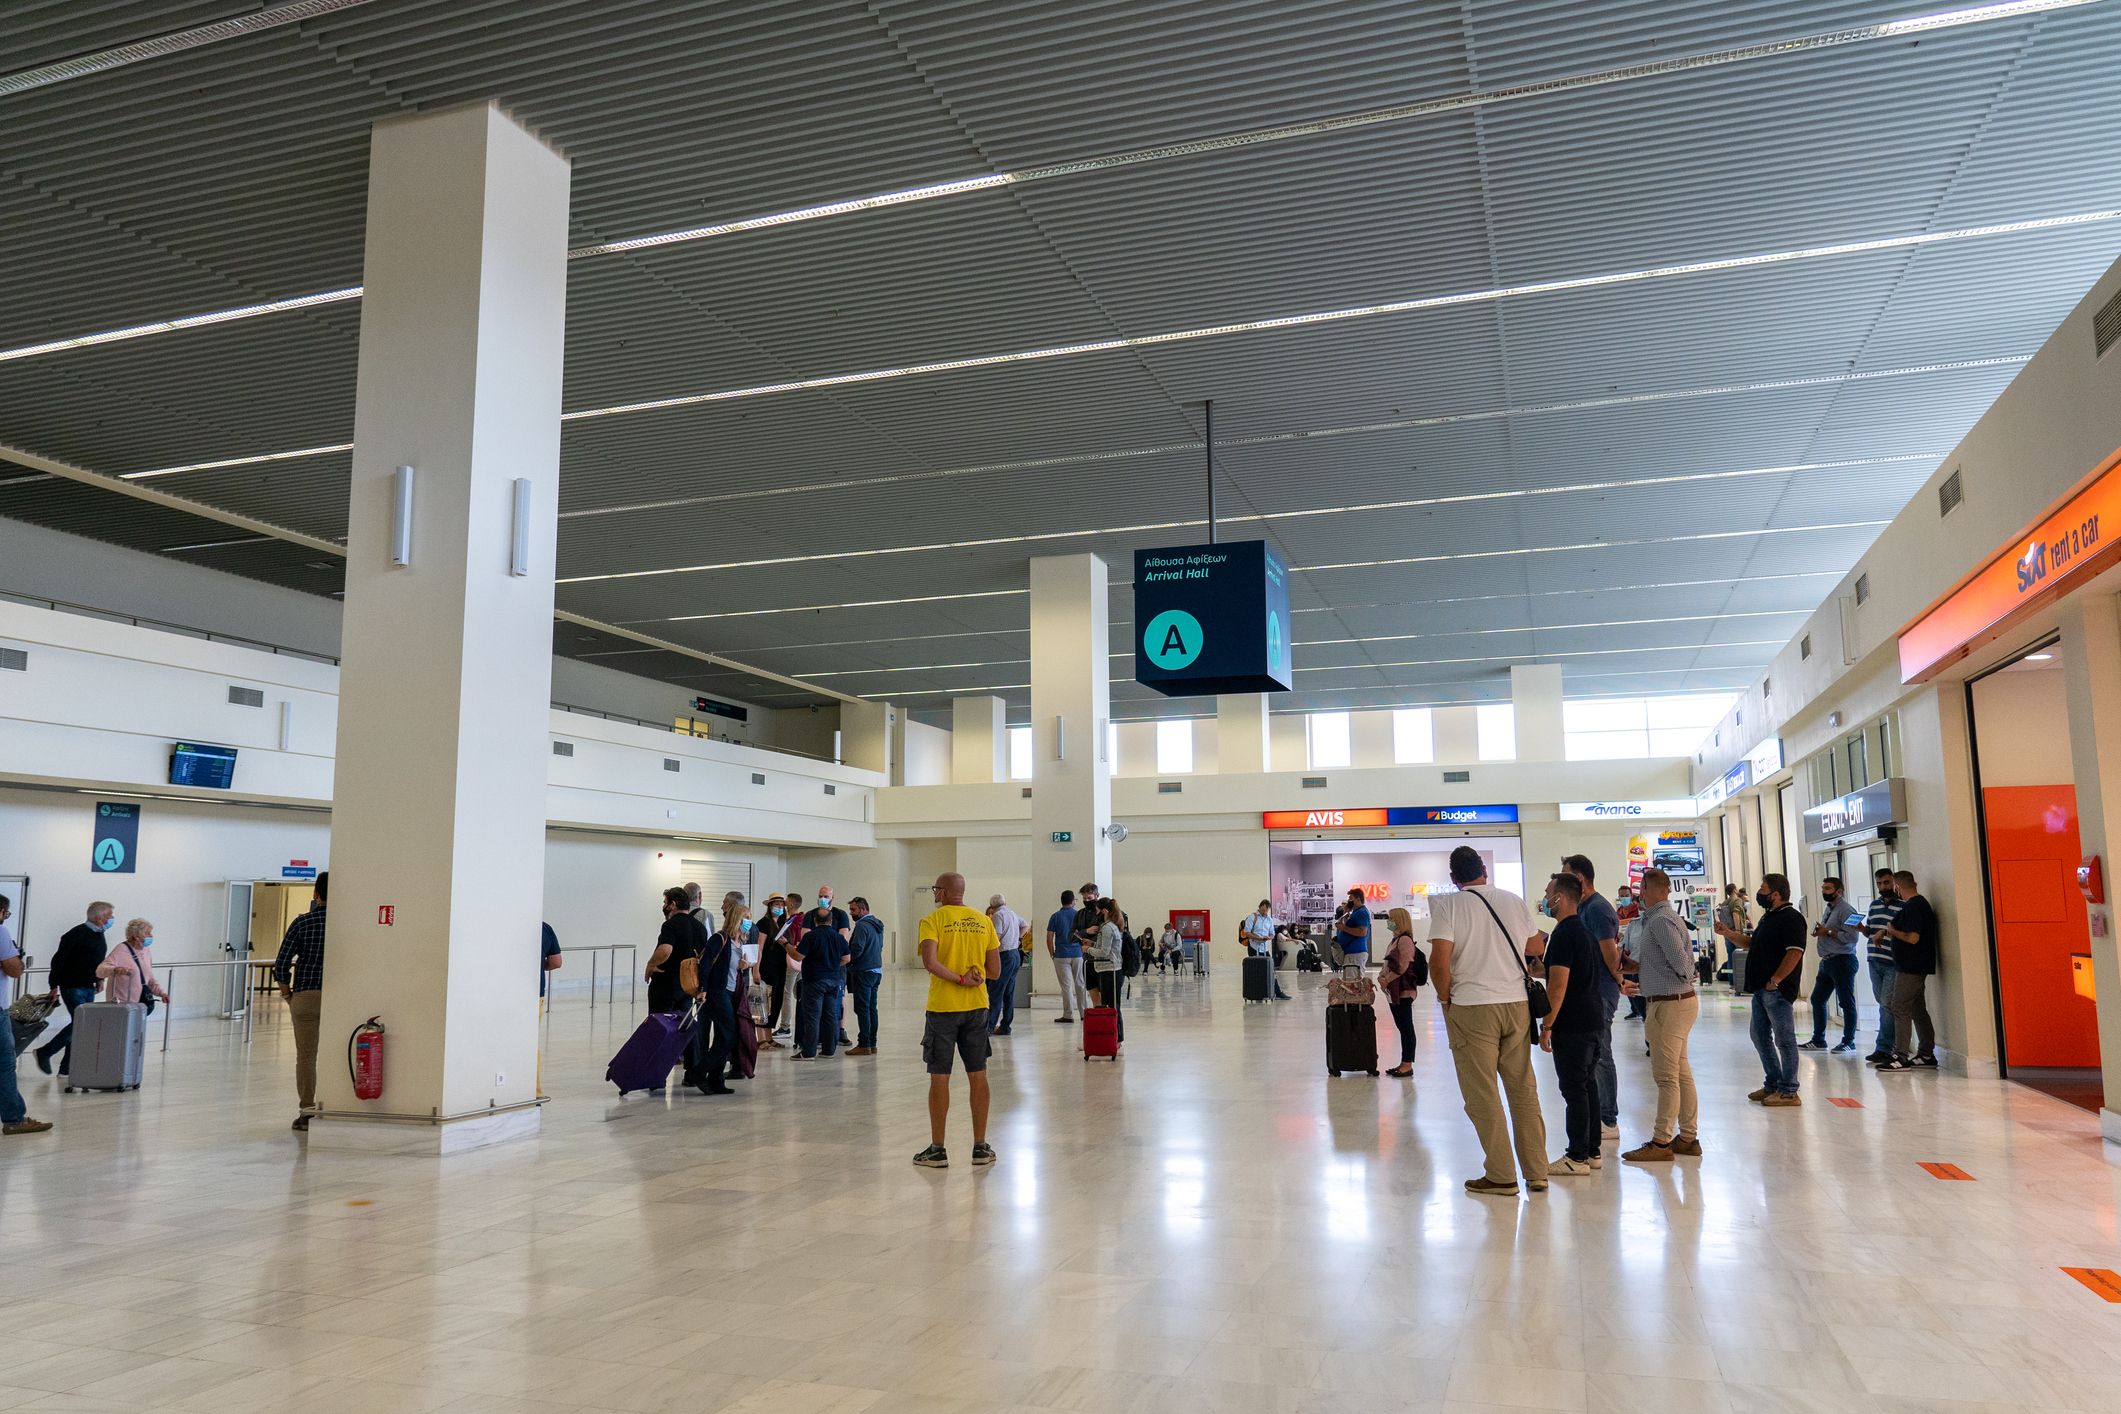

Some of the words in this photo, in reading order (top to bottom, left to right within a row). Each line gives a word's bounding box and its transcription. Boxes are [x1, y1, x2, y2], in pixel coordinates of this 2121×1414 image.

[2050, 531, 2070, 570] rent
[2072, 529, 2079, 555] a
[2081, 514, 2099, 548] car
[1144, 557, 1185, 568] Αίθουσα
[1186, 553, 1227, 566] Αφίξεων
[1145, 570, 1183, 581] Arrival
[1186, 568, 1209, 579] Hall
[1160, 624, 1188, 656] A
[1440, 810, 1478, 822] Budget
[1592, 804, 1642, 815] avance
[1848, 797, 1864, 826] EXIT
[1305, 812, 1344, 826] AVIS
[101, 843, 118, 865] A
[1351, 883, 1389, 898] VIS
